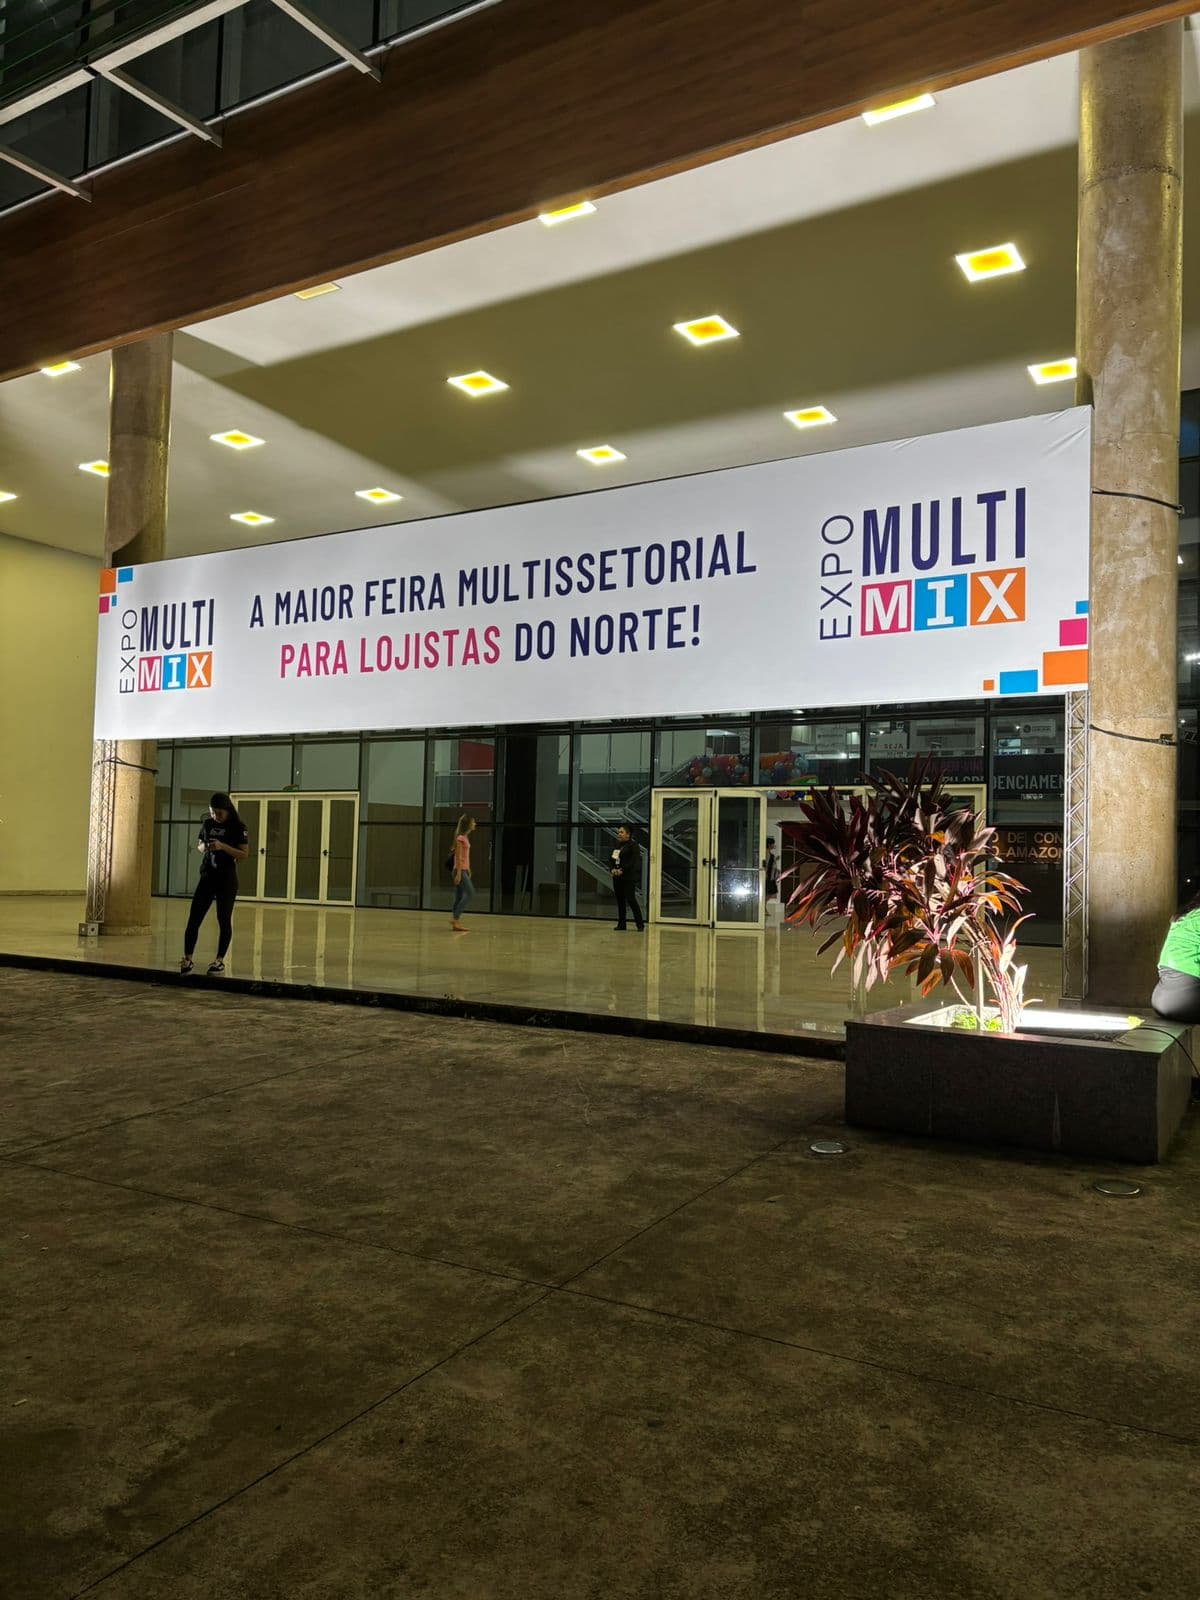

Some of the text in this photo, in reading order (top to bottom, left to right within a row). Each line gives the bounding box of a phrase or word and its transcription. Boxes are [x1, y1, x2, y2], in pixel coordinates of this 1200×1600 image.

[861, 487, 1026, 577] MULTI
[249, 531, 757, 628] A MAIOR FEIRA MULTISSETORIAL
[820, 514, 854, 641] EXPO
[863, 572, 1019, 633] MIX
[119, 608, 138, 694] EXPO
[139, 598, 215, 652] MULTI
[279, 604, 700, 679] PARA LOJISTAS DO NORTE!
[138, 653, 210, 690] MIX
[1007, 832, 1025, 844] DE
